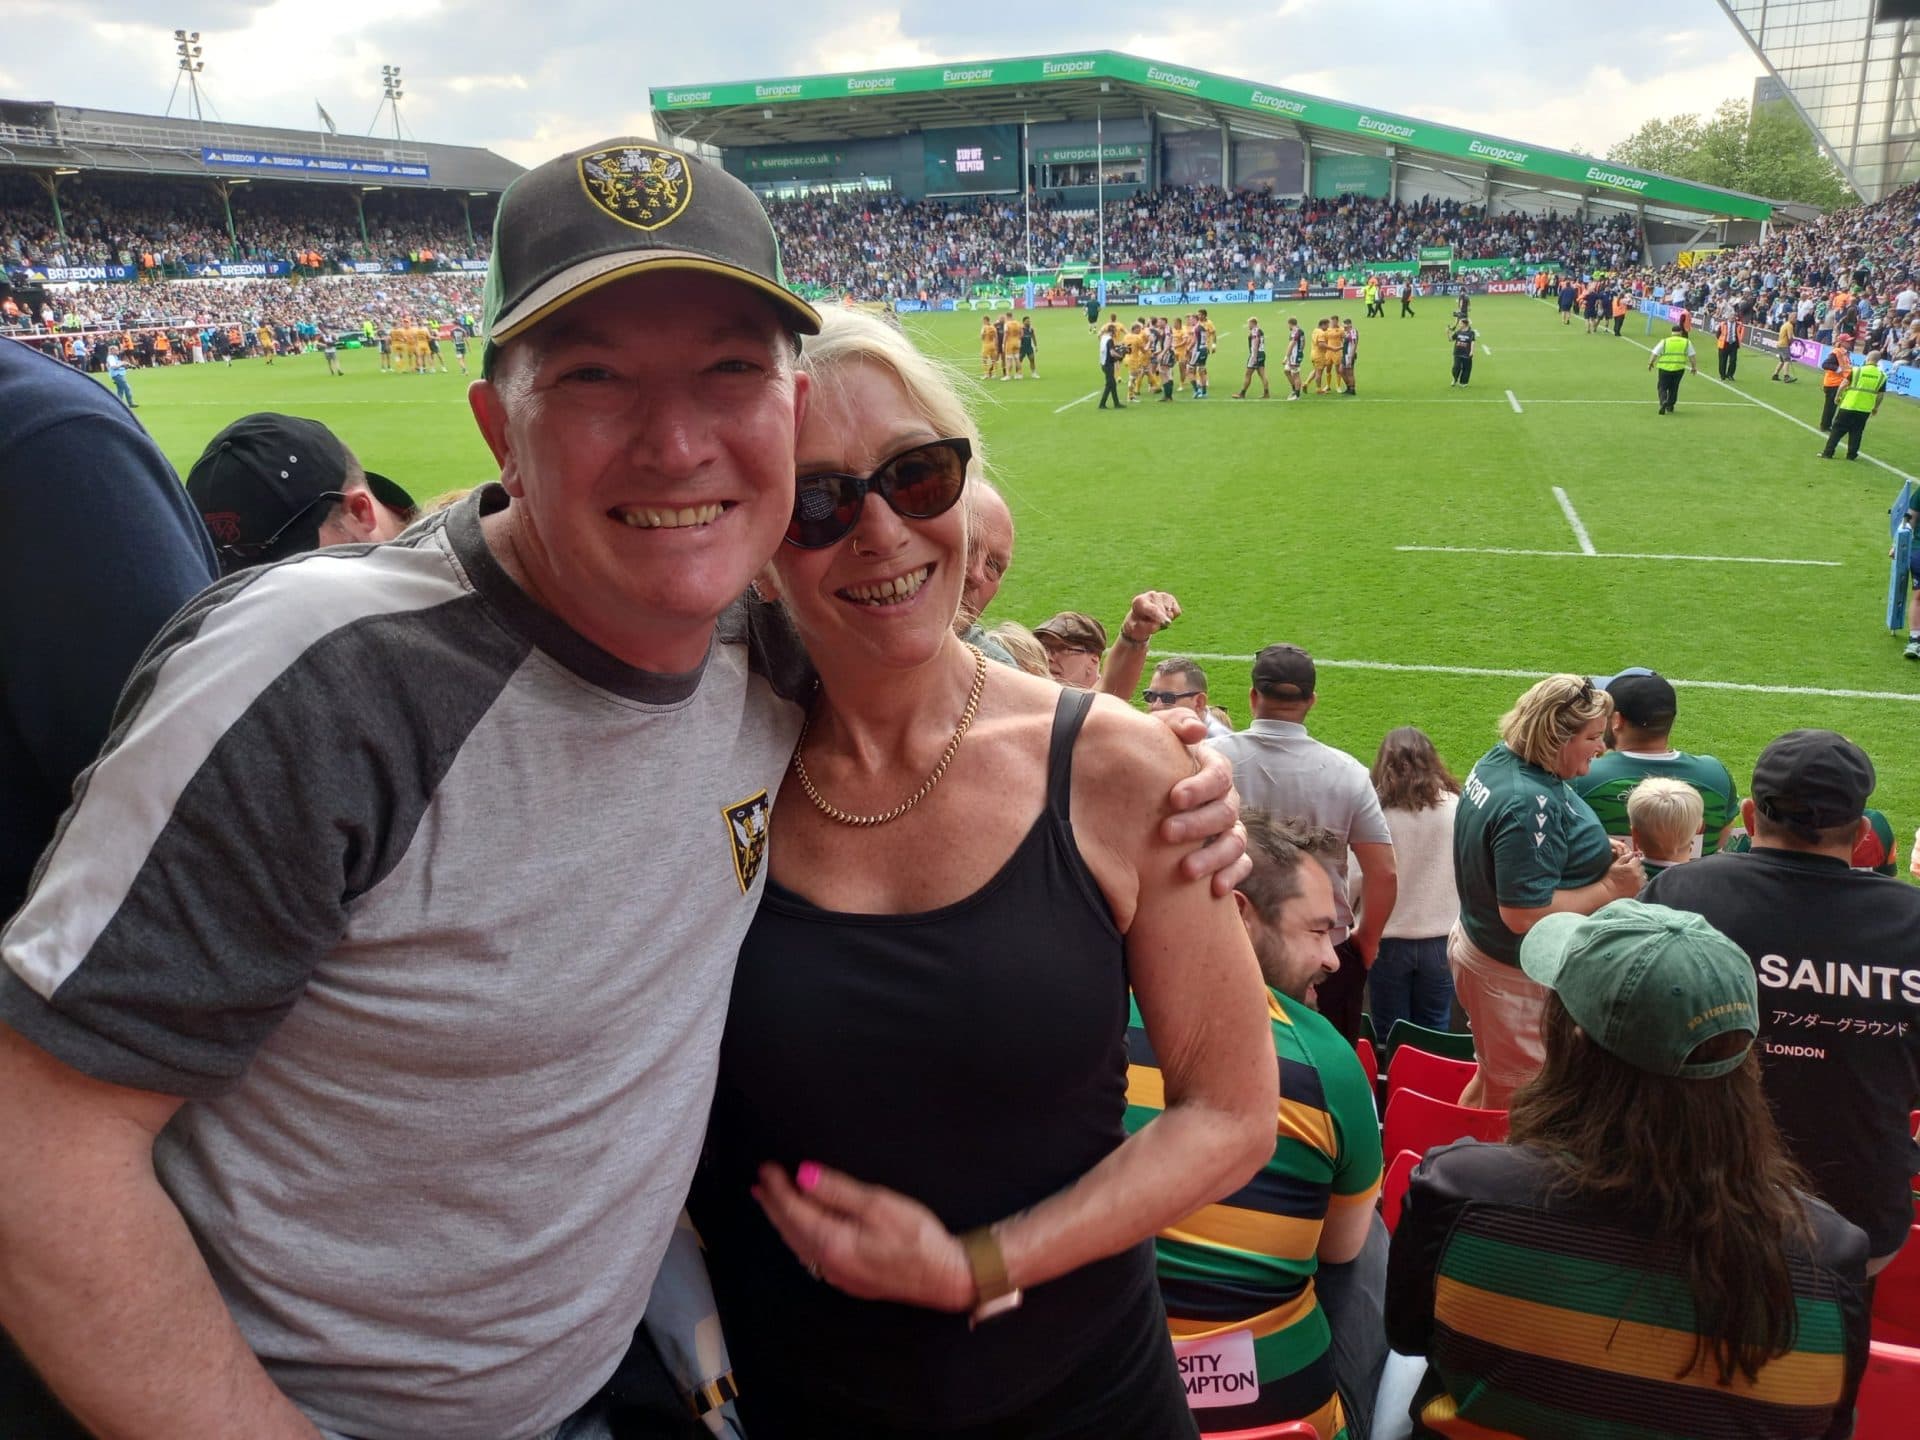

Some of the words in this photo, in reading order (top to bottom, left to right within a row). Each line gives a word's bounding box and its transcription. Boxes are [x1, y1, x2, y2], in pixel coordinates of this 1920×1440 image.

[943, 68, 994, 82] Europcar
[1043, 60, 1096, 74] Europcar
[847, 77, 896, 91] Europcar
[1147, 67, 1200, 89] Europcar
[667, 91, 712, 103] Europcar
[755, 84, 802, 98] Europcar
[1251, 90, 1307, 113] Europcar
[1357, 115, 1416, 138] Europcar
[1053, 145, 1132, 161] europcar.co.uk
[1468, 140, 1529, 163] Europcar
[762, 154, 829, 168] europcar.co.uk
[1585, 166, 1648, 190] Europcar
[47, 266, 106, 280] BREEDON
[220, 264, 266, 276] BREEDON
[1758, 953, 1920, 1004] SAINTS
[1772, 1009, 1909, 1037] アンダーグラウンド
[1765, 1042, 1825, 1059] LONDON
[1177, 1353, 1222, 1374] SITY
